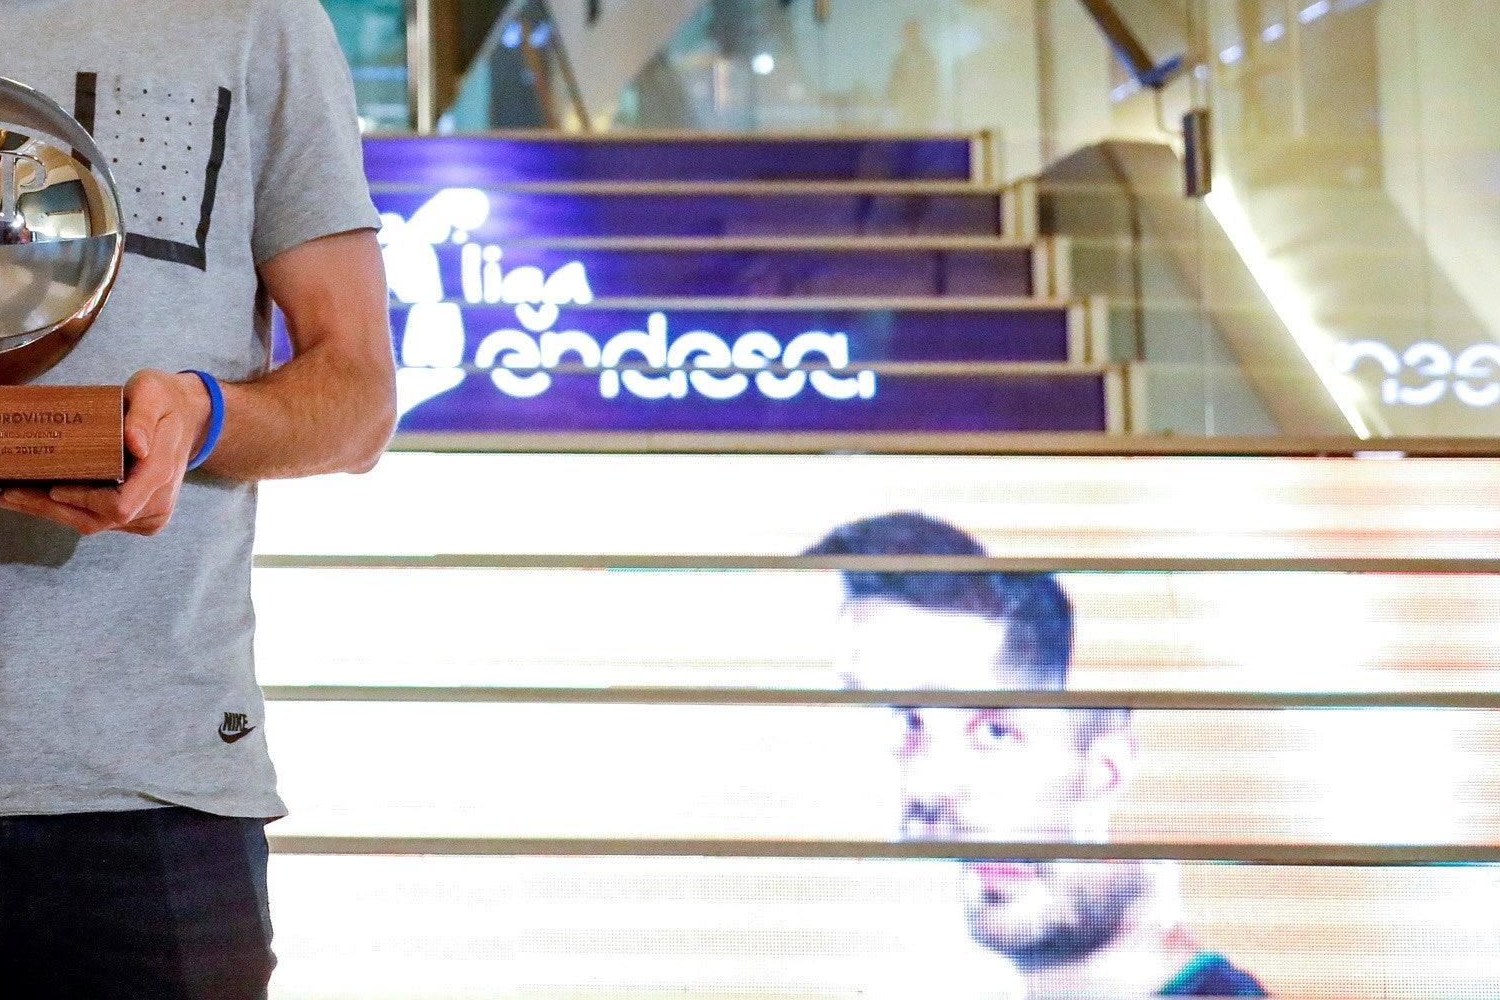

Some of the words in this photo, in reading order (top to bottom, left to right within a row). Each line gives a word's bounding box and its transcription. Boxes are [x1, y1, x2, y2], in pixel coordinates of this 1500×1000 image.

[475, 311, 877, 399] endesa
[15, 445, 55, 455] 2018/19
[222, 711, 248, 731] NIKE
